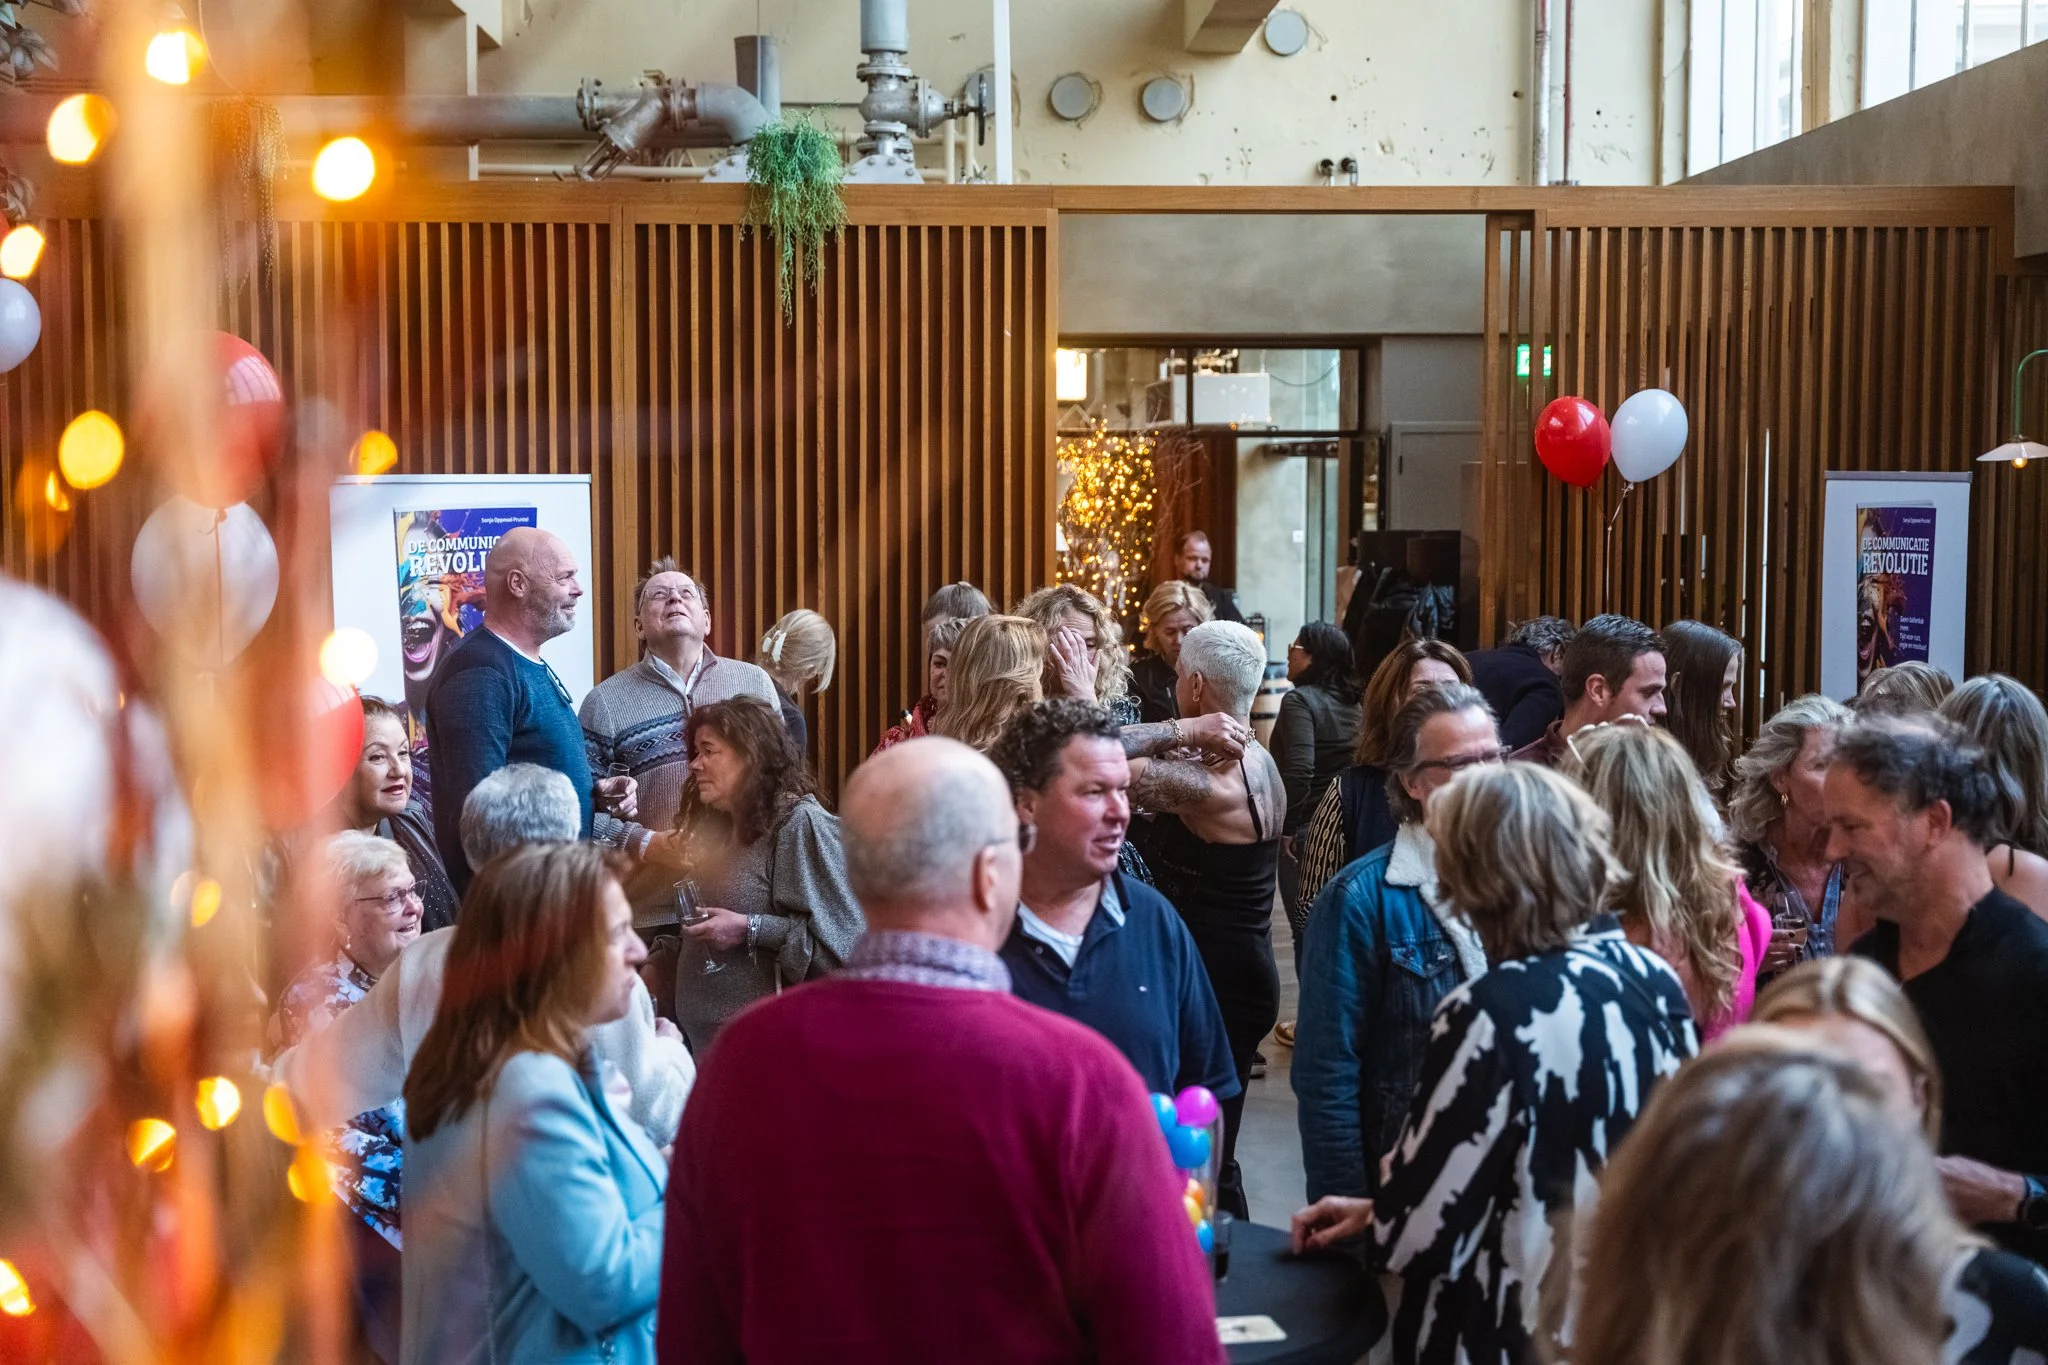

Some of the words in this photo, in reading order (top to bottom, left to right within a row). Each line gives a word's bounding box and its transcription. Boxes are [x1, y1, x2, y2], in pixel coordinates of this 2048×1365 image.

[409, 540, 427, 554] DE
[1863, 537, 1873, 550] DE
[1873, 537, 1929, 551] COMMUNICATIE
[1863, 552, 1929, 576] REVOLUTIE
